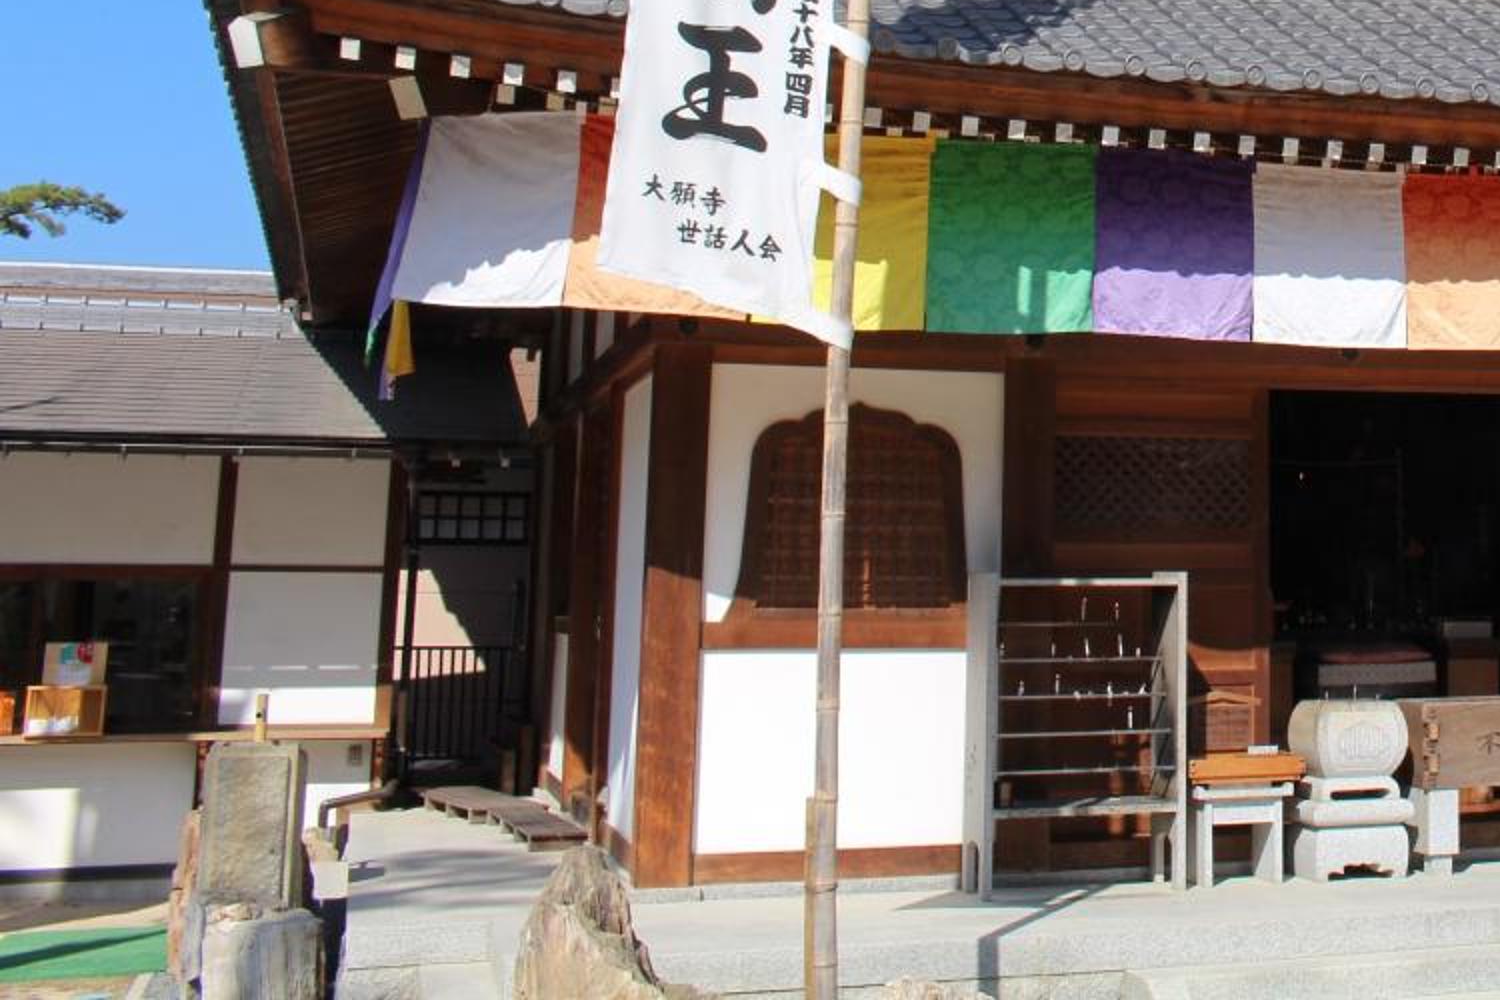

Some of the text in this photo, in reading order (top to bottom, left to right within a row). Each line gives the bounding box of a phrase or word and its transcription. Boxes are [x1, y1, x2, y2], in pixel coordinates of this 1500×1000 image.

[641, 172, 726, 217] 大願寺
[676, 217, 783, 263] 世話人会
